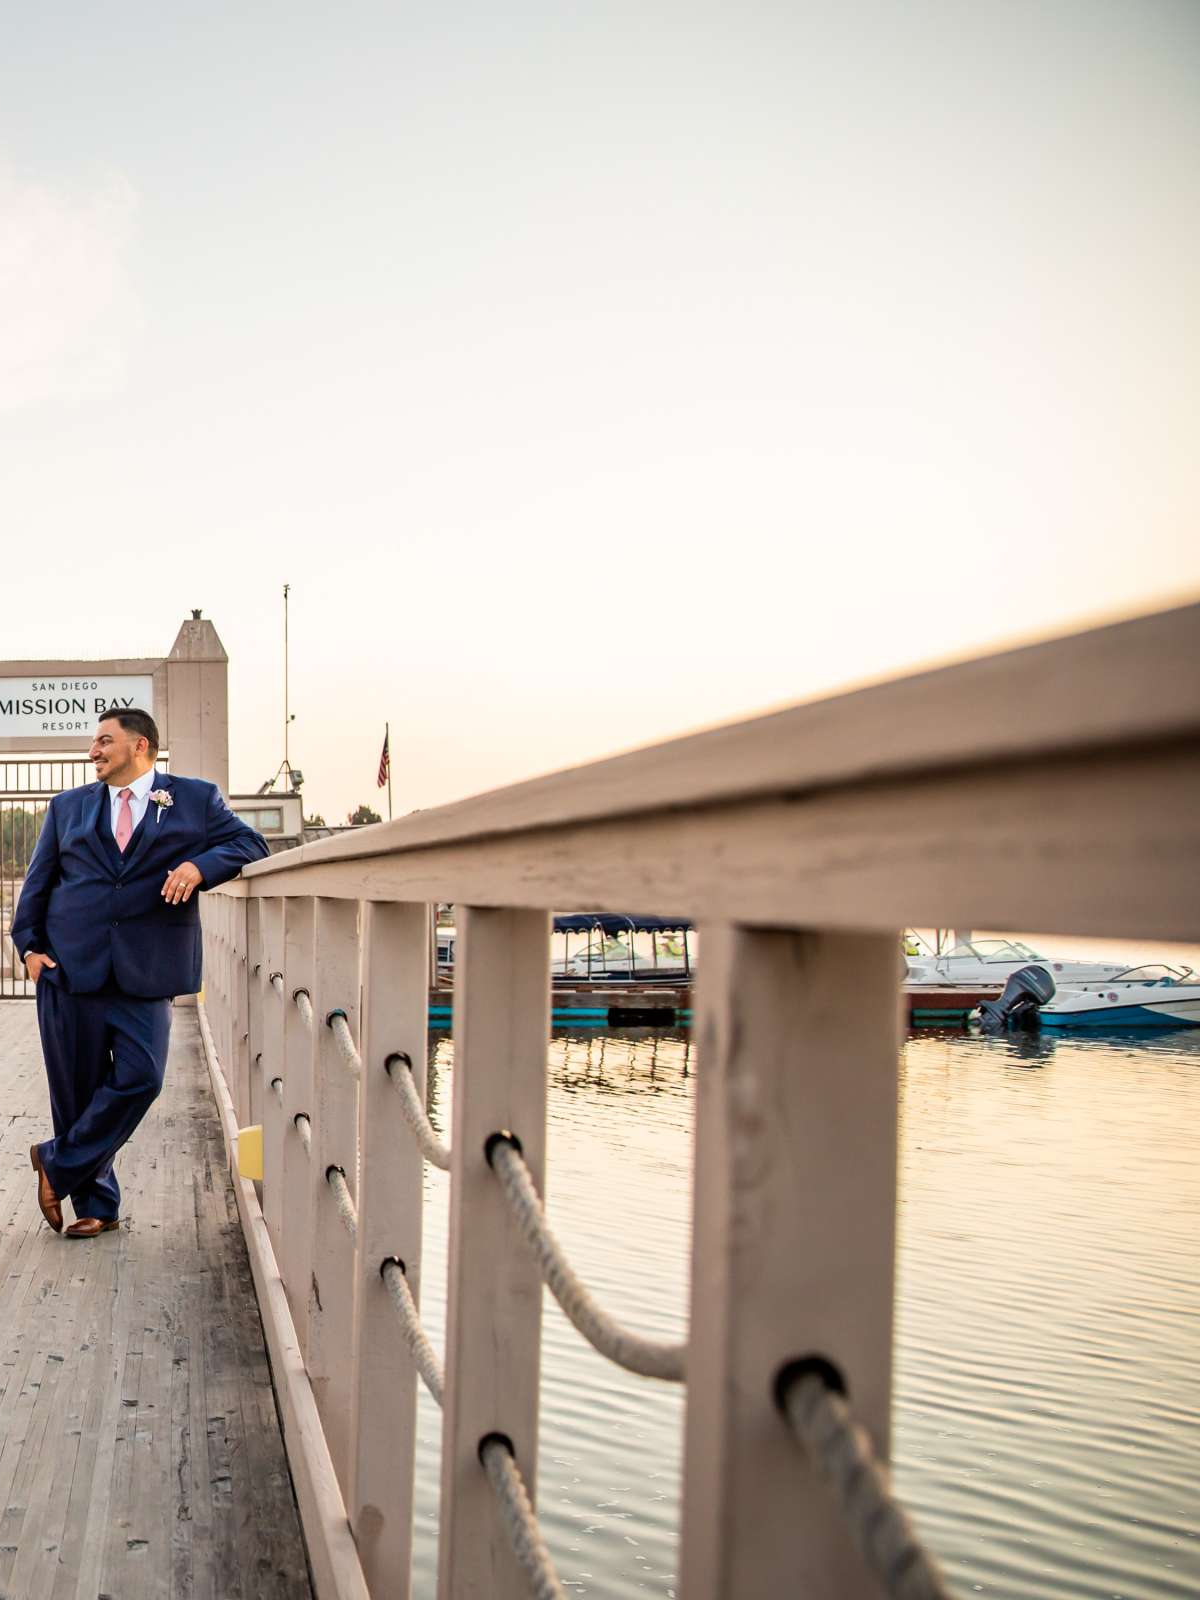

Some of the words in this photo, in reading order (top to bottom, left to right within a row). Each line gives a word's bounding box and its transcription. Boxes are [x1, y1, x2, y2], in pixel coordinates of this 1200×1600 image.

[32, 682, 55, 691] SAN
[61, 682, 98, 691] DIEGO
[94, 697, 134, 714] BAY
[42, 721, 89, 730] RESORT
